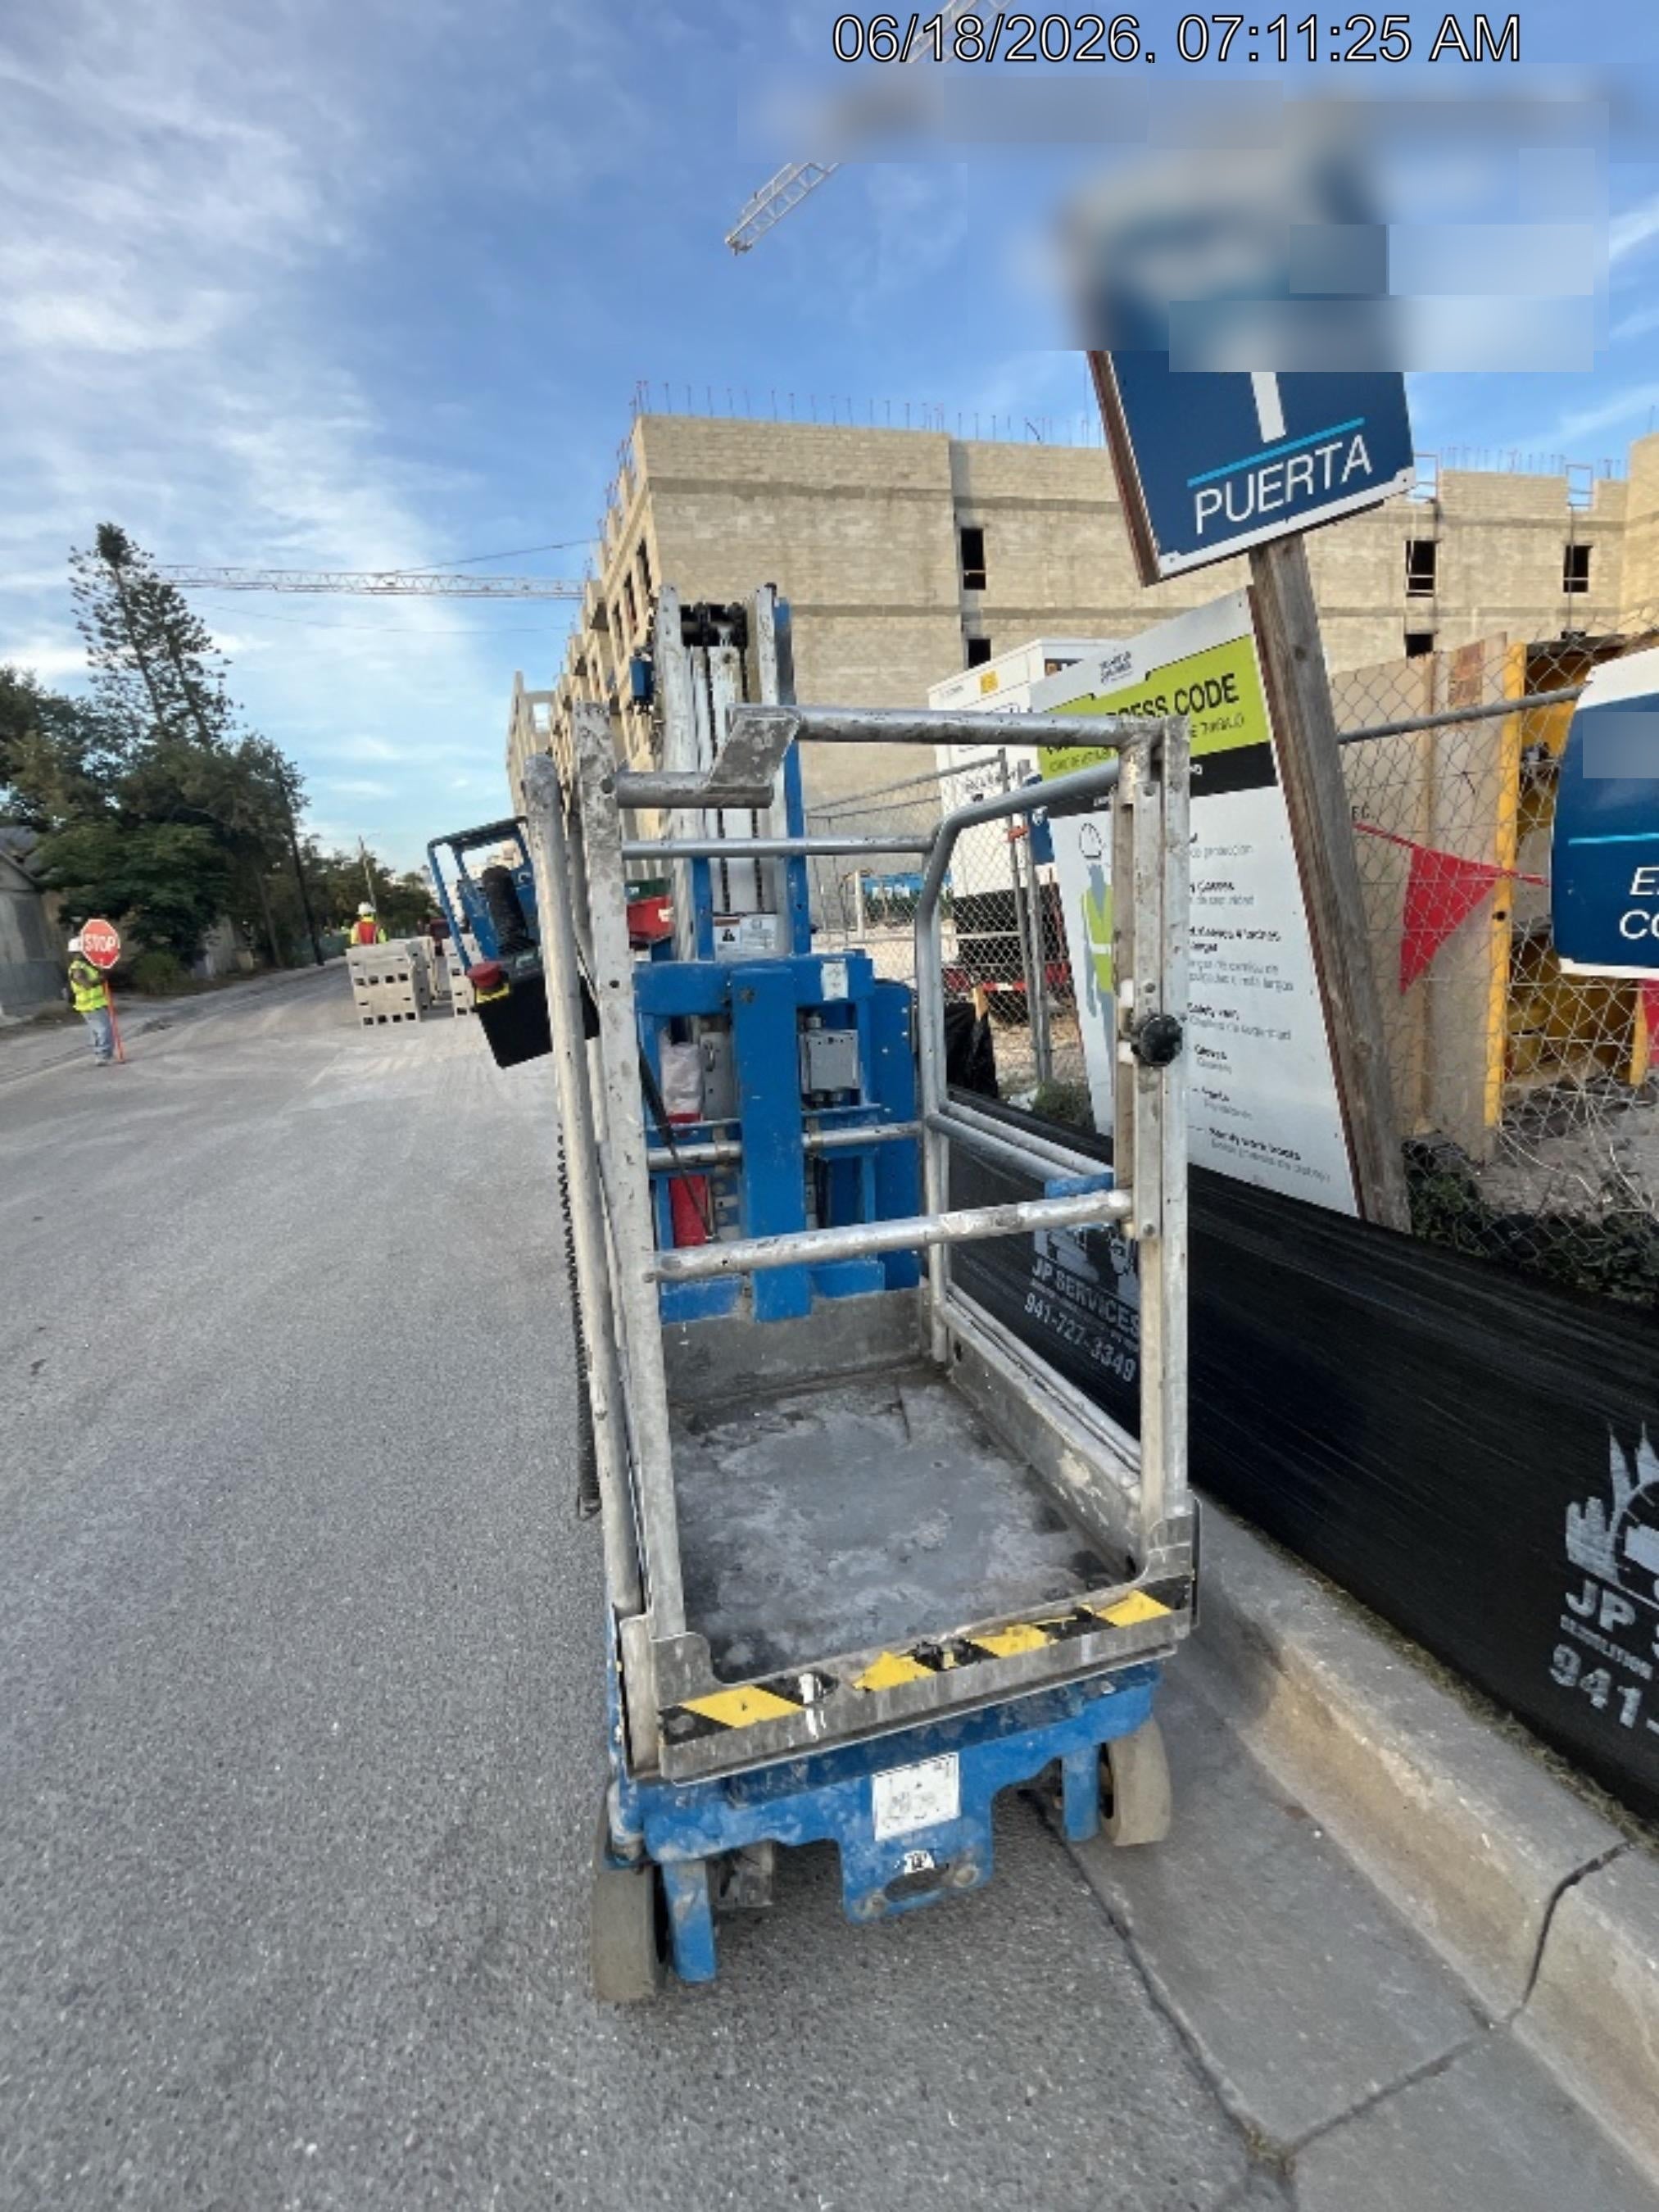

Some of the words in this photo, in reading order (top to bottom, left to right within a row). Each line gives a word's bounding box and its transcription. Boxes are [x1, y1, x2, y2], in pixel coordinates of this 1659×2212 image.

[1194, 433, 1372, 536] PUERTA
[1174, 673, 1240, 717] CODE
[84, 933, 116, 952] STOP
[1031, 1257, 1053, 1281] JP
[1565, 1579, 1637, 1633] JP
